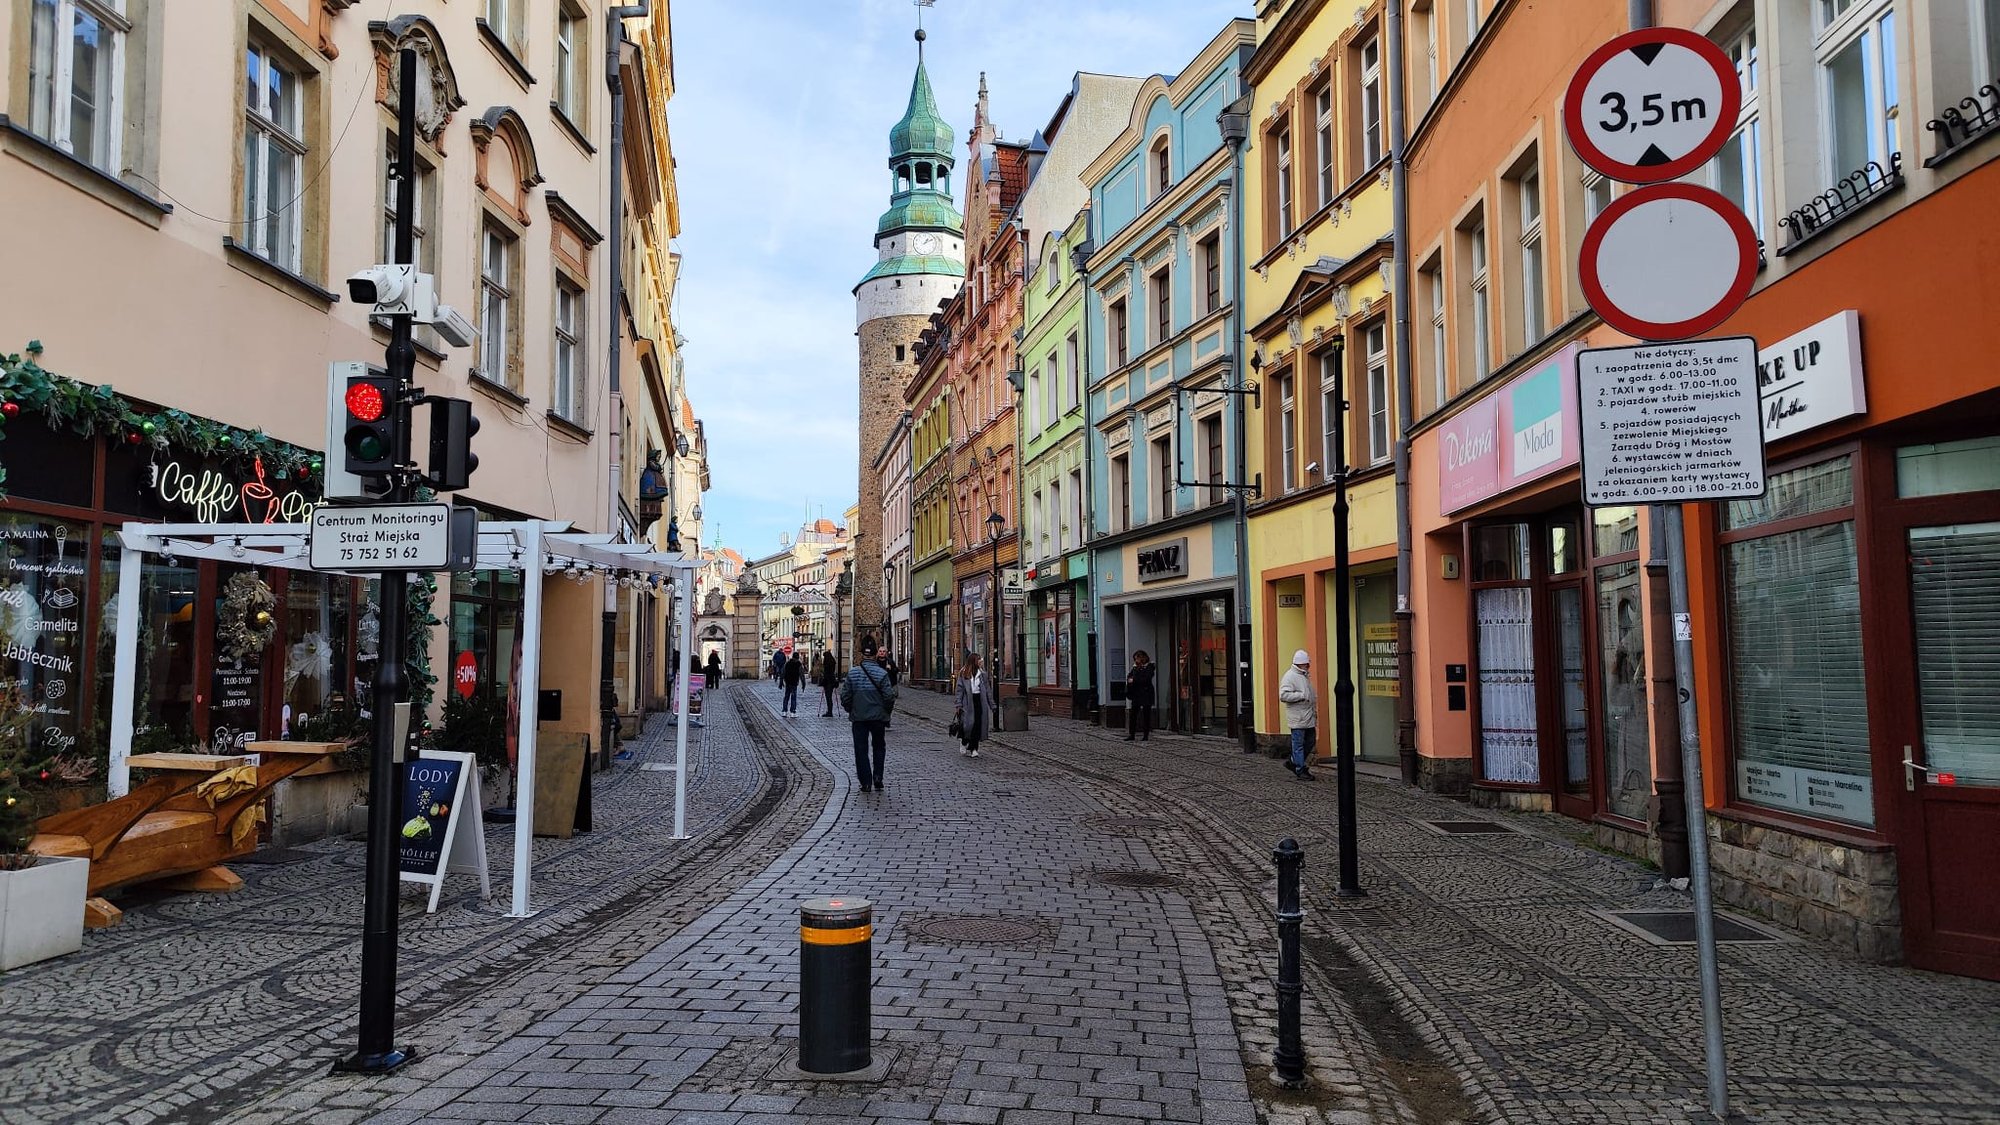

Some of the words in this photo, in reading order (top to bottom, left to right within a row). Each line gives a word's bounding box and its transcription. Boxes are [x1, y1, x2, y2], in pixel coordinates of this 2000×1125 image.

[1635, 351, 1651, 359] Nie
[1655, 348, 1696, 358] dotyczy:
[1794, 341, 1820, 371] UP
[1595, 366, 1602, 374] 1.
[1606, 361, 1671, 373] zaopatrzenia
[1675, 359, 1688, 367] do
[1717, 355, 1739, 364] dmc
[1617, 376, 1625, 384] w
[1628, 373, 1656, 384] godz.
[1660, 368, 1716, 380] 6.00-13.00
[1600, 388, 1608, 396] 2.
[1611, 385, 1634, 395] TAXI
[1649, 382, 1677, 394] godz.
[1679, 377, 1737, 390] 17.00-11.00
[1597, 399, 1606, 407] 3.
[1610, 395, 1658, 408] pojazdów
[1662, 393, 1689, 403] służb
[1692, 390, 1742, 401] miejskich
[1641, 408, 1650, 416] 4.
[1654, 405, 1697, 415] rowerów
[1600, 421, 1609, 430] 5.
[1613, 418, 1661, 431] pojazdów
[1665, 413, 1741, 428] posiadających
[1524, 421, 1554, 458] Moda
[1613, 429, 1668, 440] zezwolenie
[1671, 425, 1728, 437] Miejskiego
[1611, 442, 1652, 453] Zarządu
[1655, 440, 1680, 450] Dróg
[1691, 437, 1732, 447] Mostów
[1611, 454, 1621, 463] 6.
[1624, 451, 1681, 463] wystawców
[1697, 448, 1733, 458] dniach
[1604, 463, 1682, 477] jeleniogórskich
[1685, 459, 1742, 472] jarmarków
[1612, 474, 1668, 486] okazaniem
[1671, 473, 1698, 484] karty
[1700, 471, 1751, 483] wystawcy
[162, 462, 238, 523] Caffe
[1602, 488, 1629, 500] godz.
[1633, 485, 1685, 497] 6.00-9.00
[1695, 481, 1759, 493] 18.00-21.00
[317, 516, 365, 527] Centrum
[372, 512, 444, 526] Monitoringu
[13, 530, 49, 539] MALINA
[340, 531, 369, 543] Straż
[375, 530, 420, 544] Miejska
[341, 549, 353, 560] 75
[359, 548, 379, 560] 752
[385, 547, 397, 559] 51
[403, 547, 418, 558] 62
[24, 616, 78, 632] Carmelita
[3, 641, 74, 673] Jabłecznik
[43, 726, 76, 751] Beza
[409, 766, 453, 784] LODY
[1834, 780, 1863, 792] Marcelina
